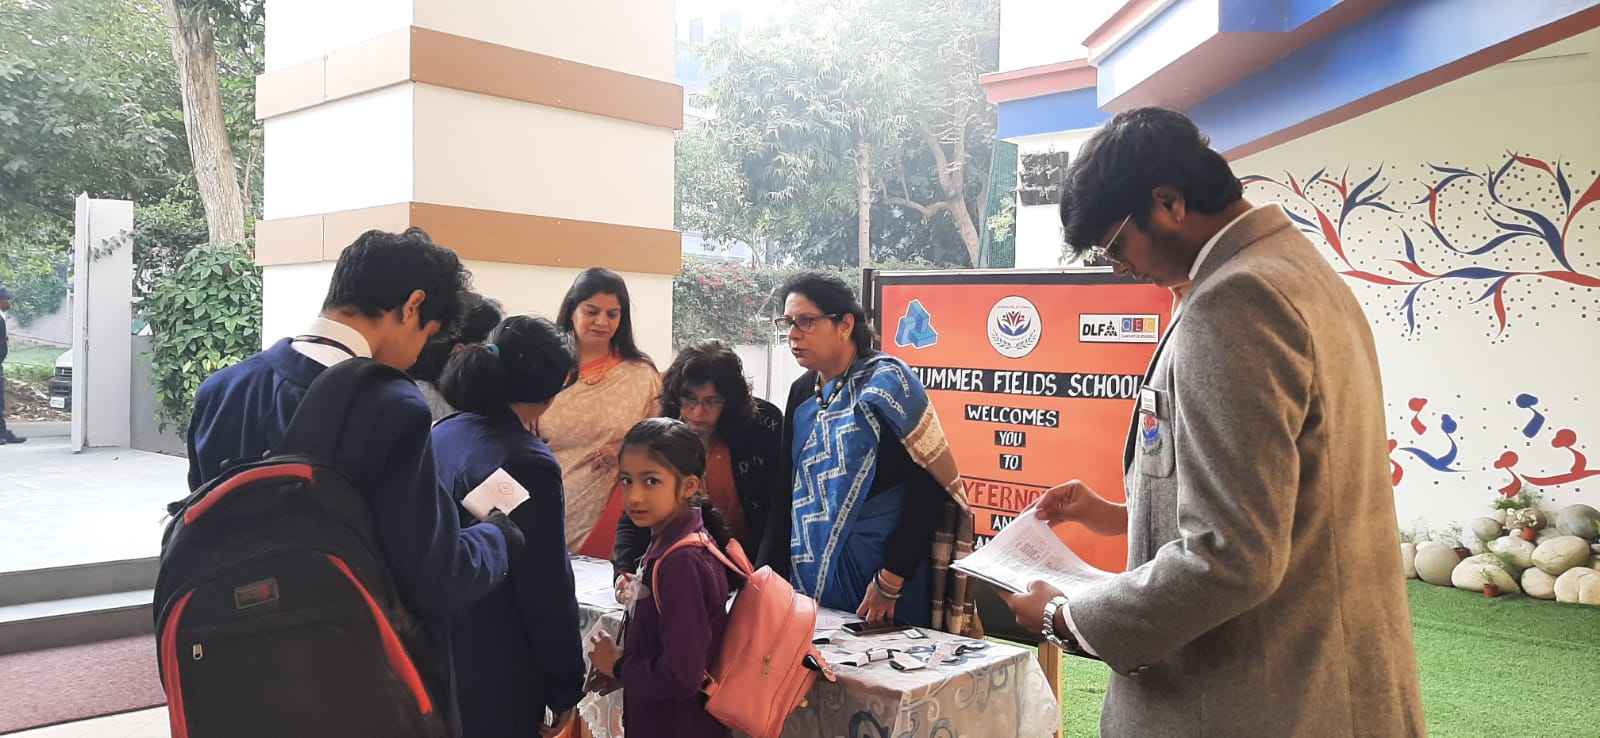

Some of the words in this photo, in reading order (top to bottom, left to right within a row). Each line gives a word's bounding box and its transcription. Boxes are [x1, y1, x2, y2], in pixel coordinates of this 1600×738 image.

[1082, 323, 1105, 336] DLF
[993, 375, 1057, 396] FIELDS
[967, 405, 1057, 426] WELCOMES
[999, 431, 1022, 447] YOU
[1002, 454, 1019, 470] TO
